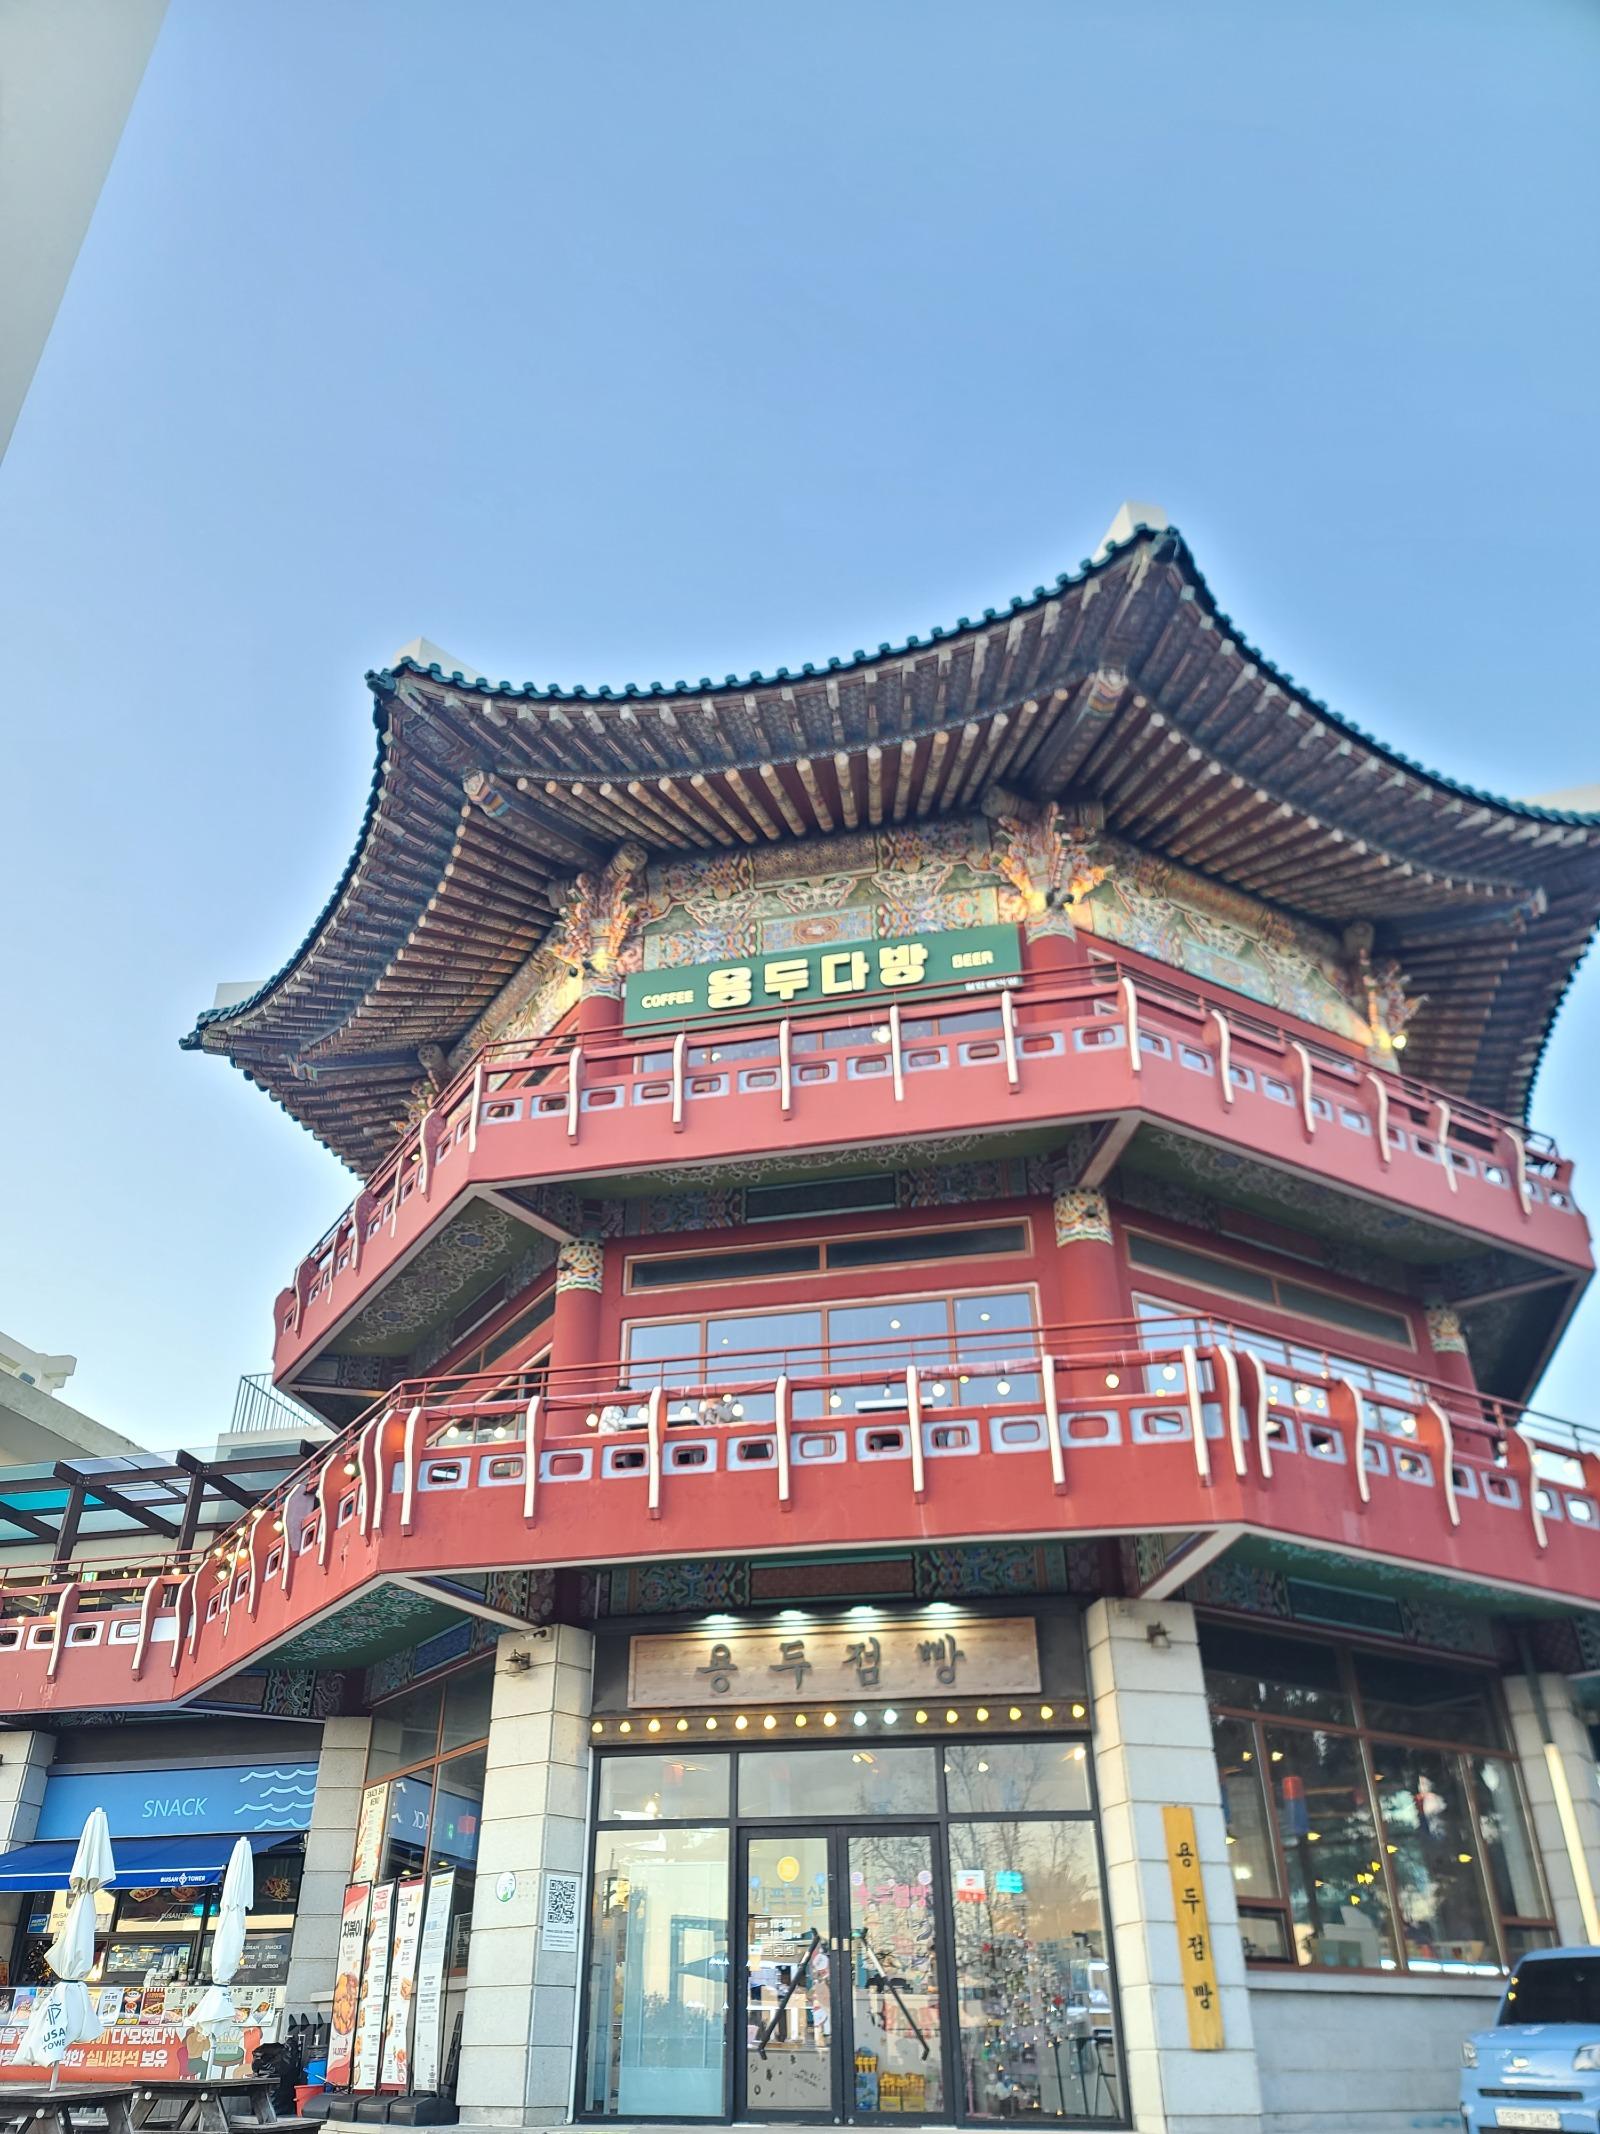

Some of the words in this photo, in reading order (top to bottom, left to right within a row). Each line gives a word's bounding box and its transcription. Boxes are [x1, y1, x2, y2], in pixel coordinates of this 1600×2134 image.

[951, 950, 994, 969] BEER
[706, 942, 929, 1009] 용두다방
[641, 990, 694, 1009] COFFEE
[696, 1632, 965, 1694] 용두점빵
[142, 1797, 208, 1818] SNACK
[1175, 1842, 1214, 2010] 용두점빵
[43, 2027, 67, 2042] USA
[43, 2039, 66, 2053] TOWE
[85, 2048, 140, 2067] 실내좌석
[140, 2048, 168, 2068] 보유
